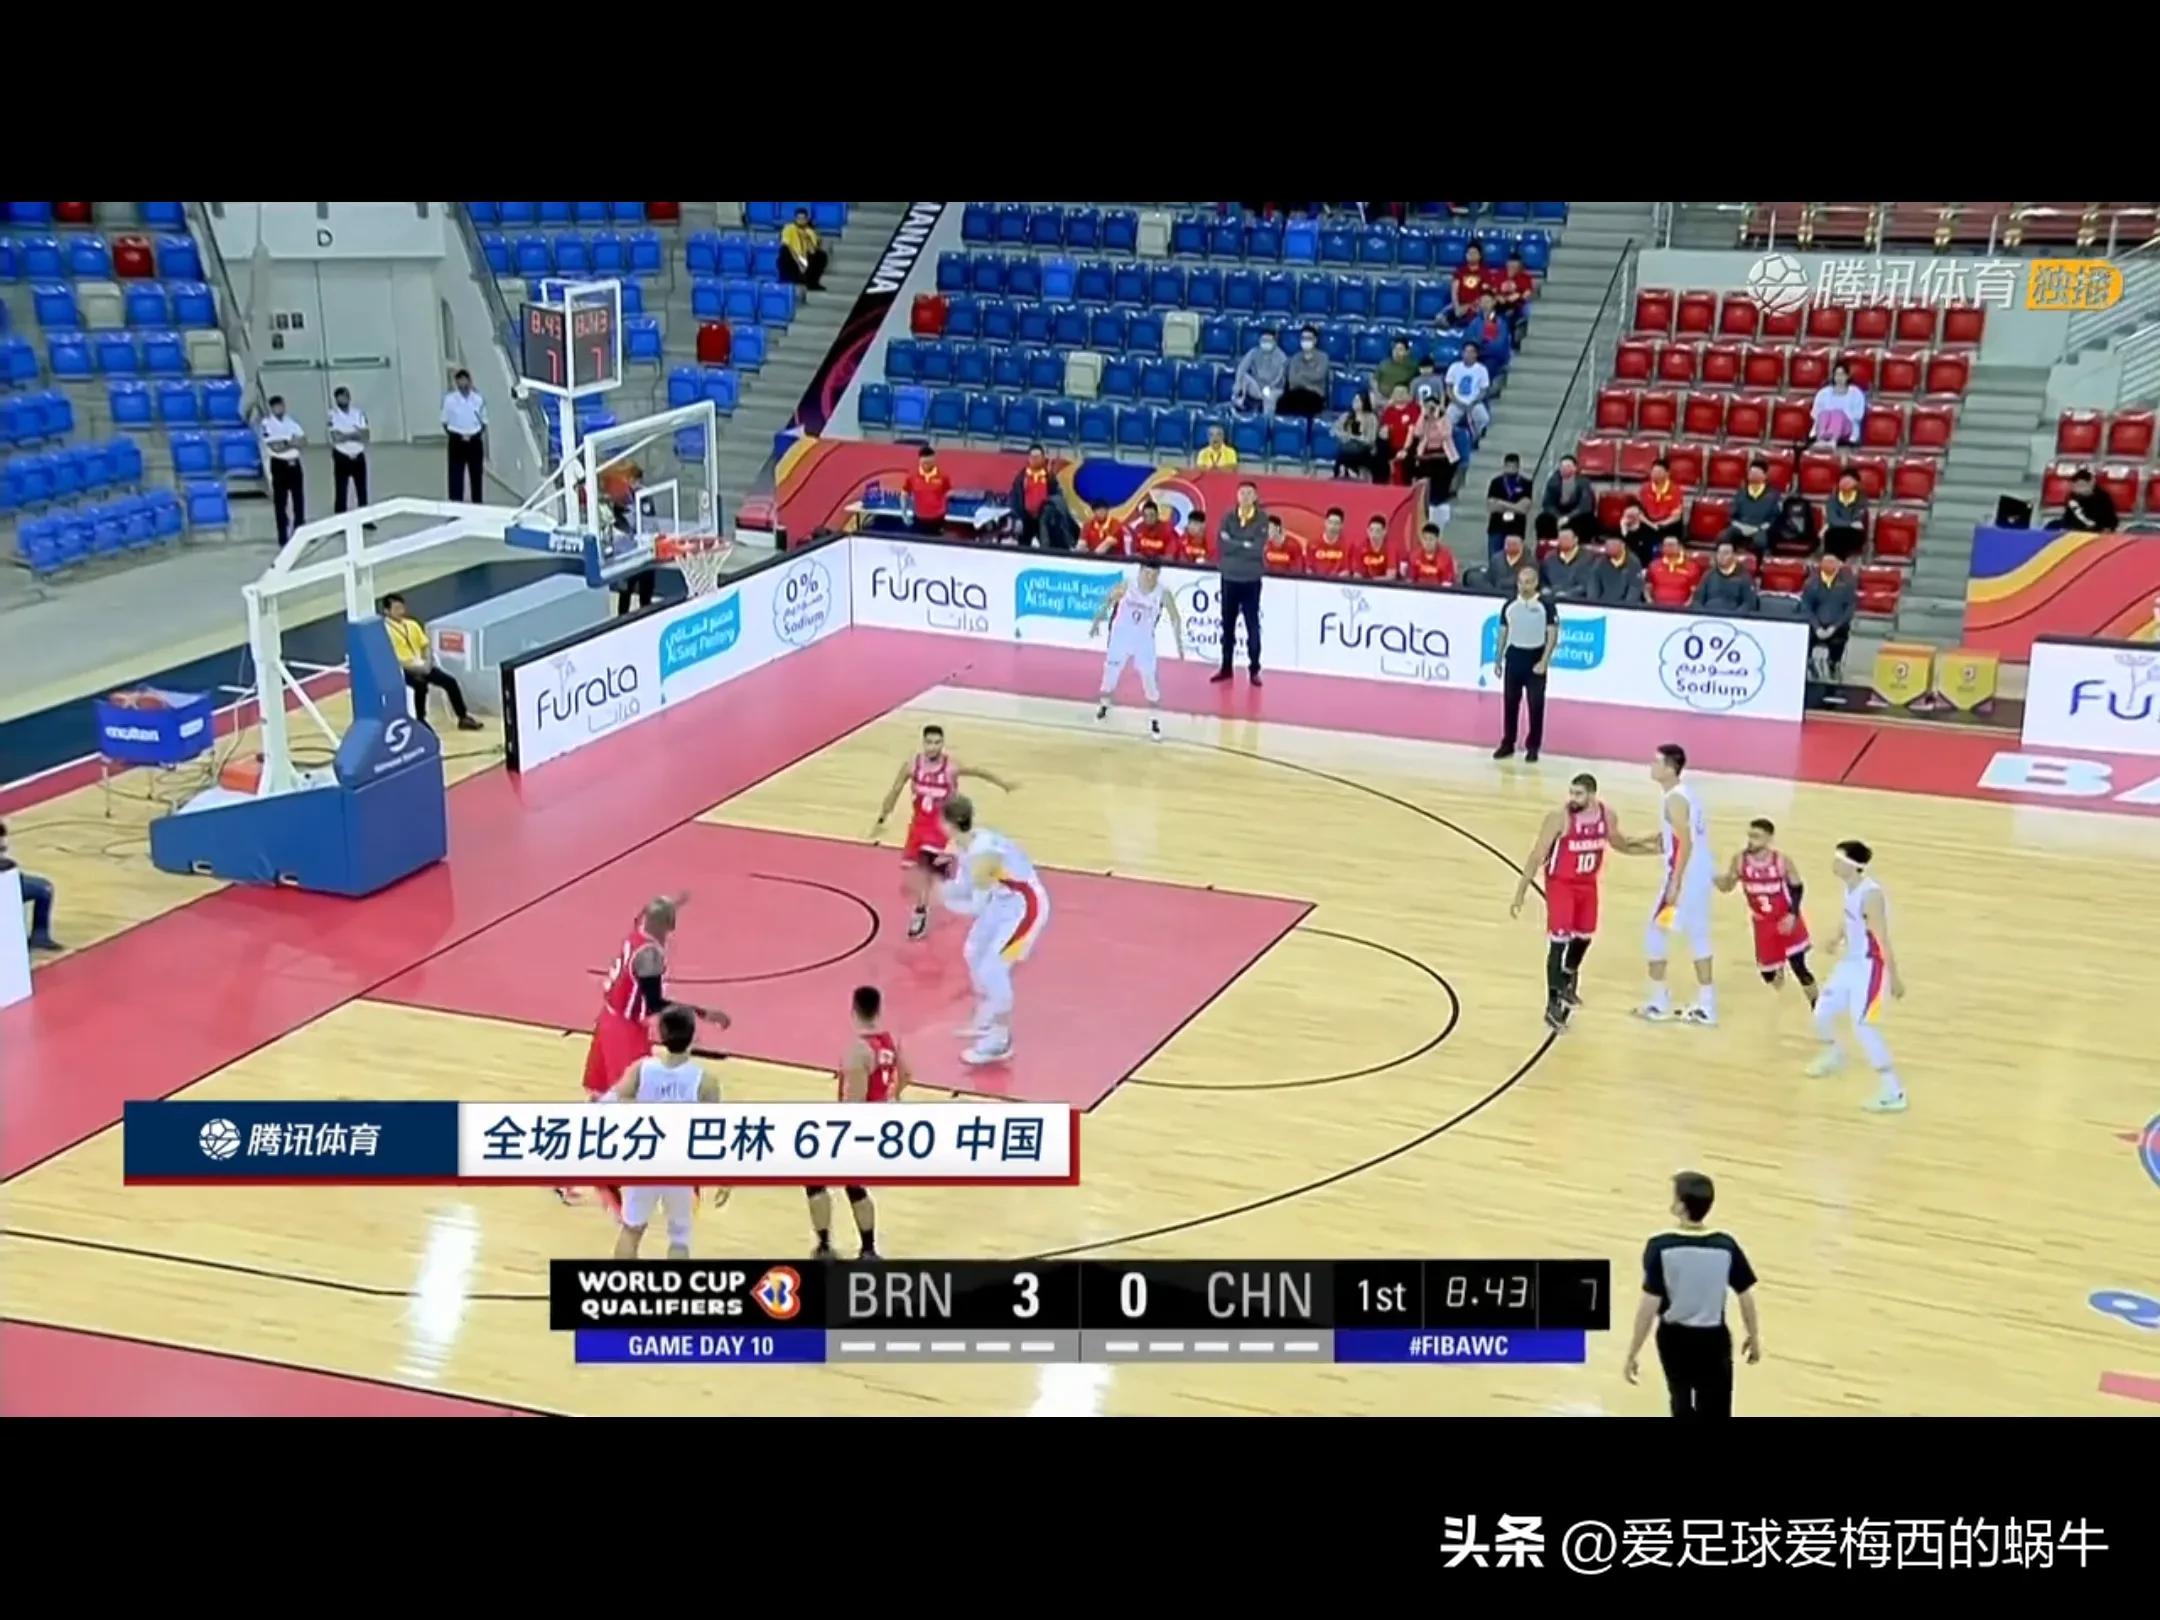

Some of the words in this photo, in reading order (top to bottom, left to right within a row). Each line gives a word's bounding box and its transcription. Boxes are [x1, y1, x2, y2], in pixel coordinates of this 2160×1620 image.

[317, 229, 333, 247] D
[786, 570, 819, 604] 0%
[1684, 635, 1741, 663] 0%
[1676, 678, 1748, 697] Sodium
[1576, 853, 1596, 872] 10
